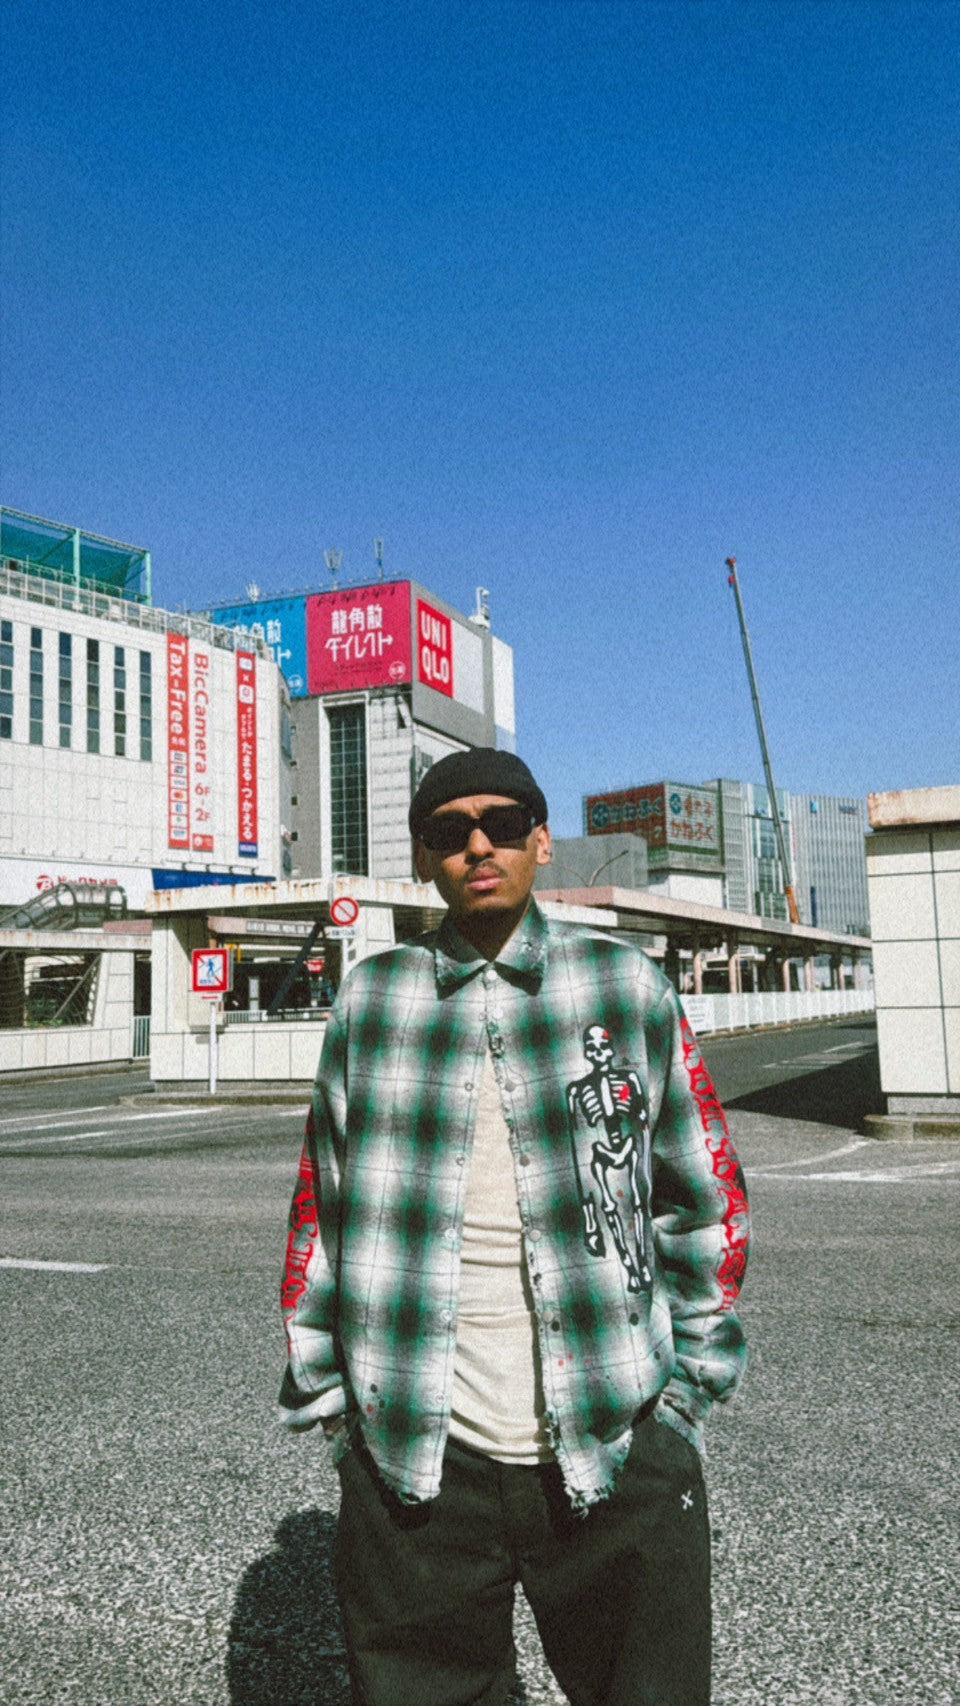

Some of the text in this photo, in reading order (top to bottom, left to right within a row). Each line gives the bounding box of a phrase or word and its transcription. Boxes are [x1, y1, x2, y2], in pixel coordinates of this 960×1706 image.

[330, 604, 384, 636] 龍角散
[421, 610, 447, 651] UNI
[421, 648, 451, 685] QLO
[170, 642, 187, 735] Tax-Free
[194, 652, 210, 774] BicCamera
[194, 783, 211, 796] 6F
[194, 808, 211, 822] 2F
